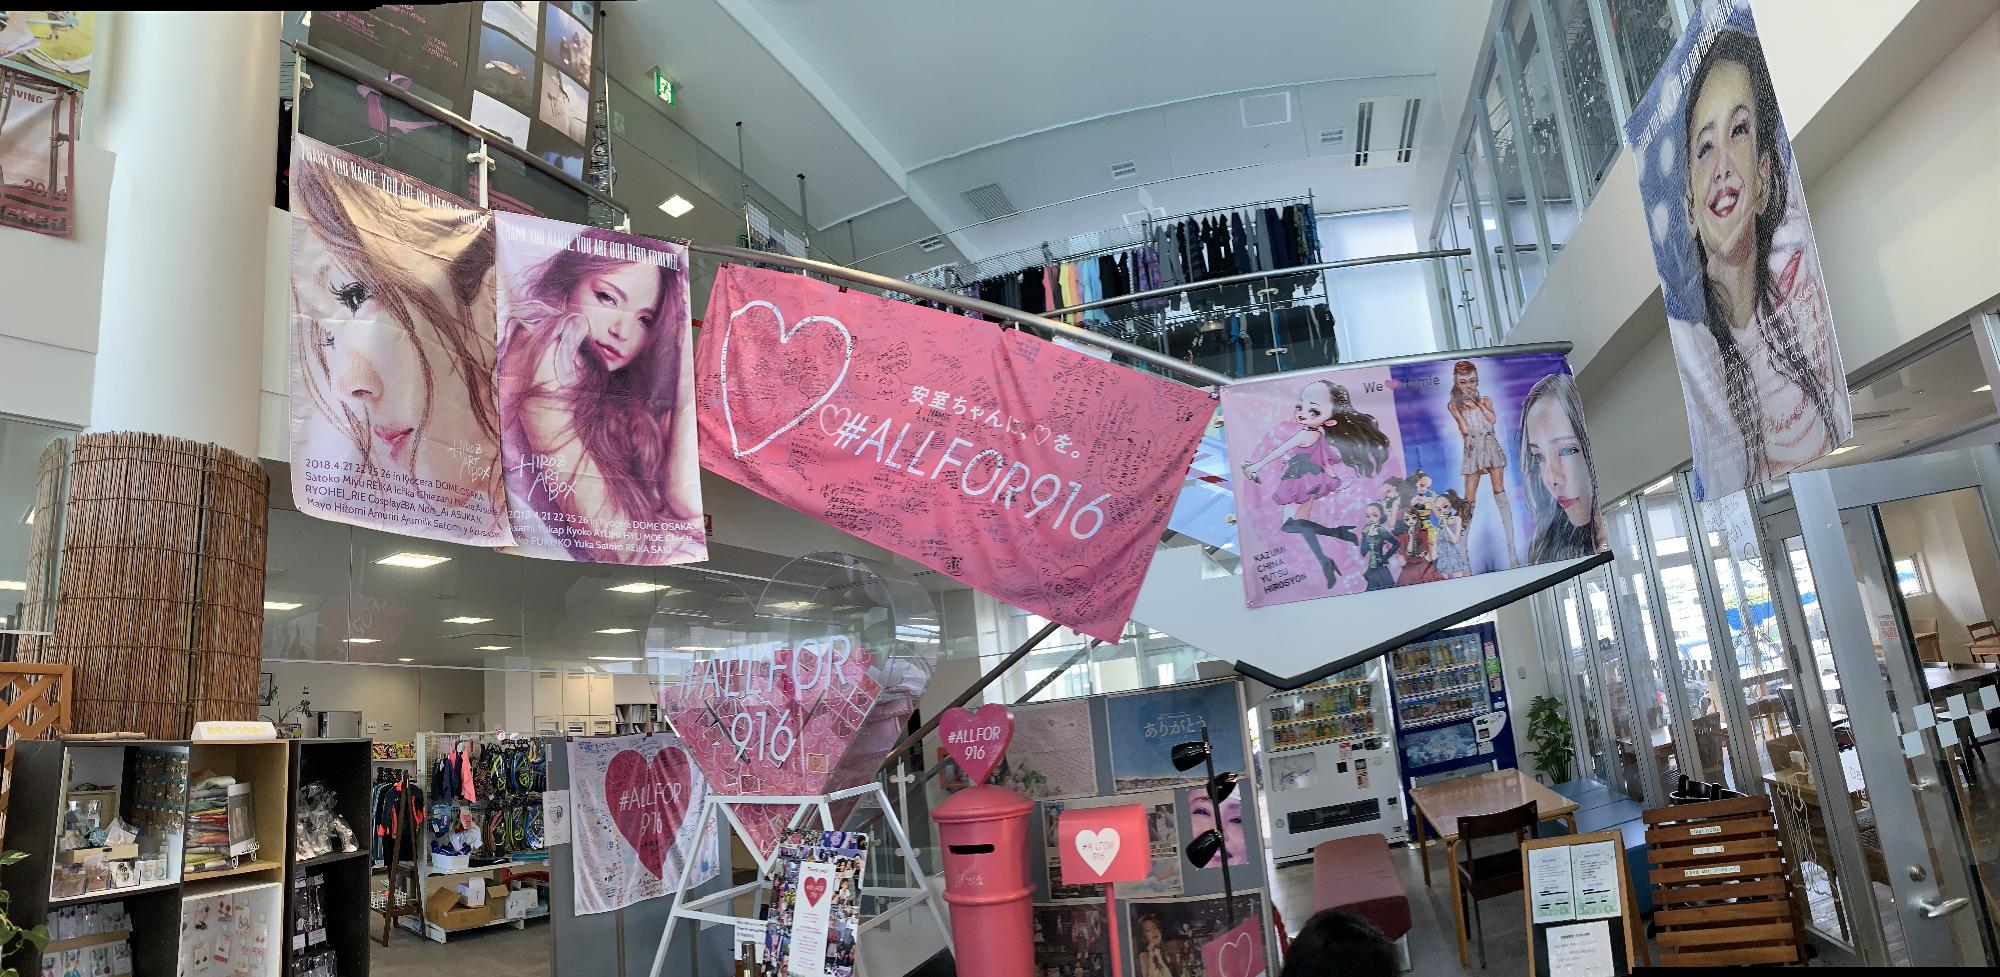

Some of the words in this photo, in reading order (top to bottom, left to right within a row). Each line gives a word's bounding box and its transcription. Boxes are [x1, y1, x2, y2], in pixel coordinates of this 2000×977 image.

[300, 138, 329, 169] THANK
[331, 155, 349, 178] YOU
[381, 172, 398, 197] YOU
[400, 184, 414, 200] ARE
[416, 187, 430, 208] OUR
[432, 193, 452, 214] HERO
[576, 234, 592, 254] YOU
[594, 238, 608, 257] ARE
[609, 242, 626, 260] OUR
[626, 242, 646, 265] HERO
[648, 250, 681, 272] FOREVER.
[363, 382, 384, 394] We
[401, 376, 440, 390] Namie
[305, 458, 353, 472] 2018.4.21
[355, 464, 366, 474] 22
[380, 468, 391, 479] 26
[393, 472, 400, 482] in
[459, 456, 480, 480] ART
[471, 466, 491, 483] BOX
[834, 413, 1112, 541] #ALLFOR916
[305, 471, 340, 483] Satoko
[342, 474, 365, 489] Miyu
[366, 480, 392, 494] REIKA
[527, 470, 560, 502] ART
[548, 480, 576, 503] BOX
[306, 497, 332, 512] Mayo
[334, 502, 366, 516] Hitomi
[553, 512, 564, 522] 22
[566, 514, 576, 523] 25
[578, 515, 588, 524] 26
[632, 520, 660, 531] DOME
[566, 526, 592, 538] Kyoko
[644, 533, 664, 542] MOE
[574, 540, 594, 549] Yuka
[596, 541, 624, 552] Satoko
[650, 545, 672, 554] SAKI
[1256, 559, 1286, 573] CHINA
[1260, 568, 1288, 583] YUTSU
[1264, 573, 1308, 594] HIROSYON
[675, 634, 852, 701] #ALLFOR
[731, 708, 796, 763] 916
[948, 726, 1001, 744] #ALLFOR
[1144, 715, 1206, 738] ありがとう
[964, 745, 986, 761] 916
[618, 782, 682, 812] #ALLFOR
[640, 812, 663, 837] 916
